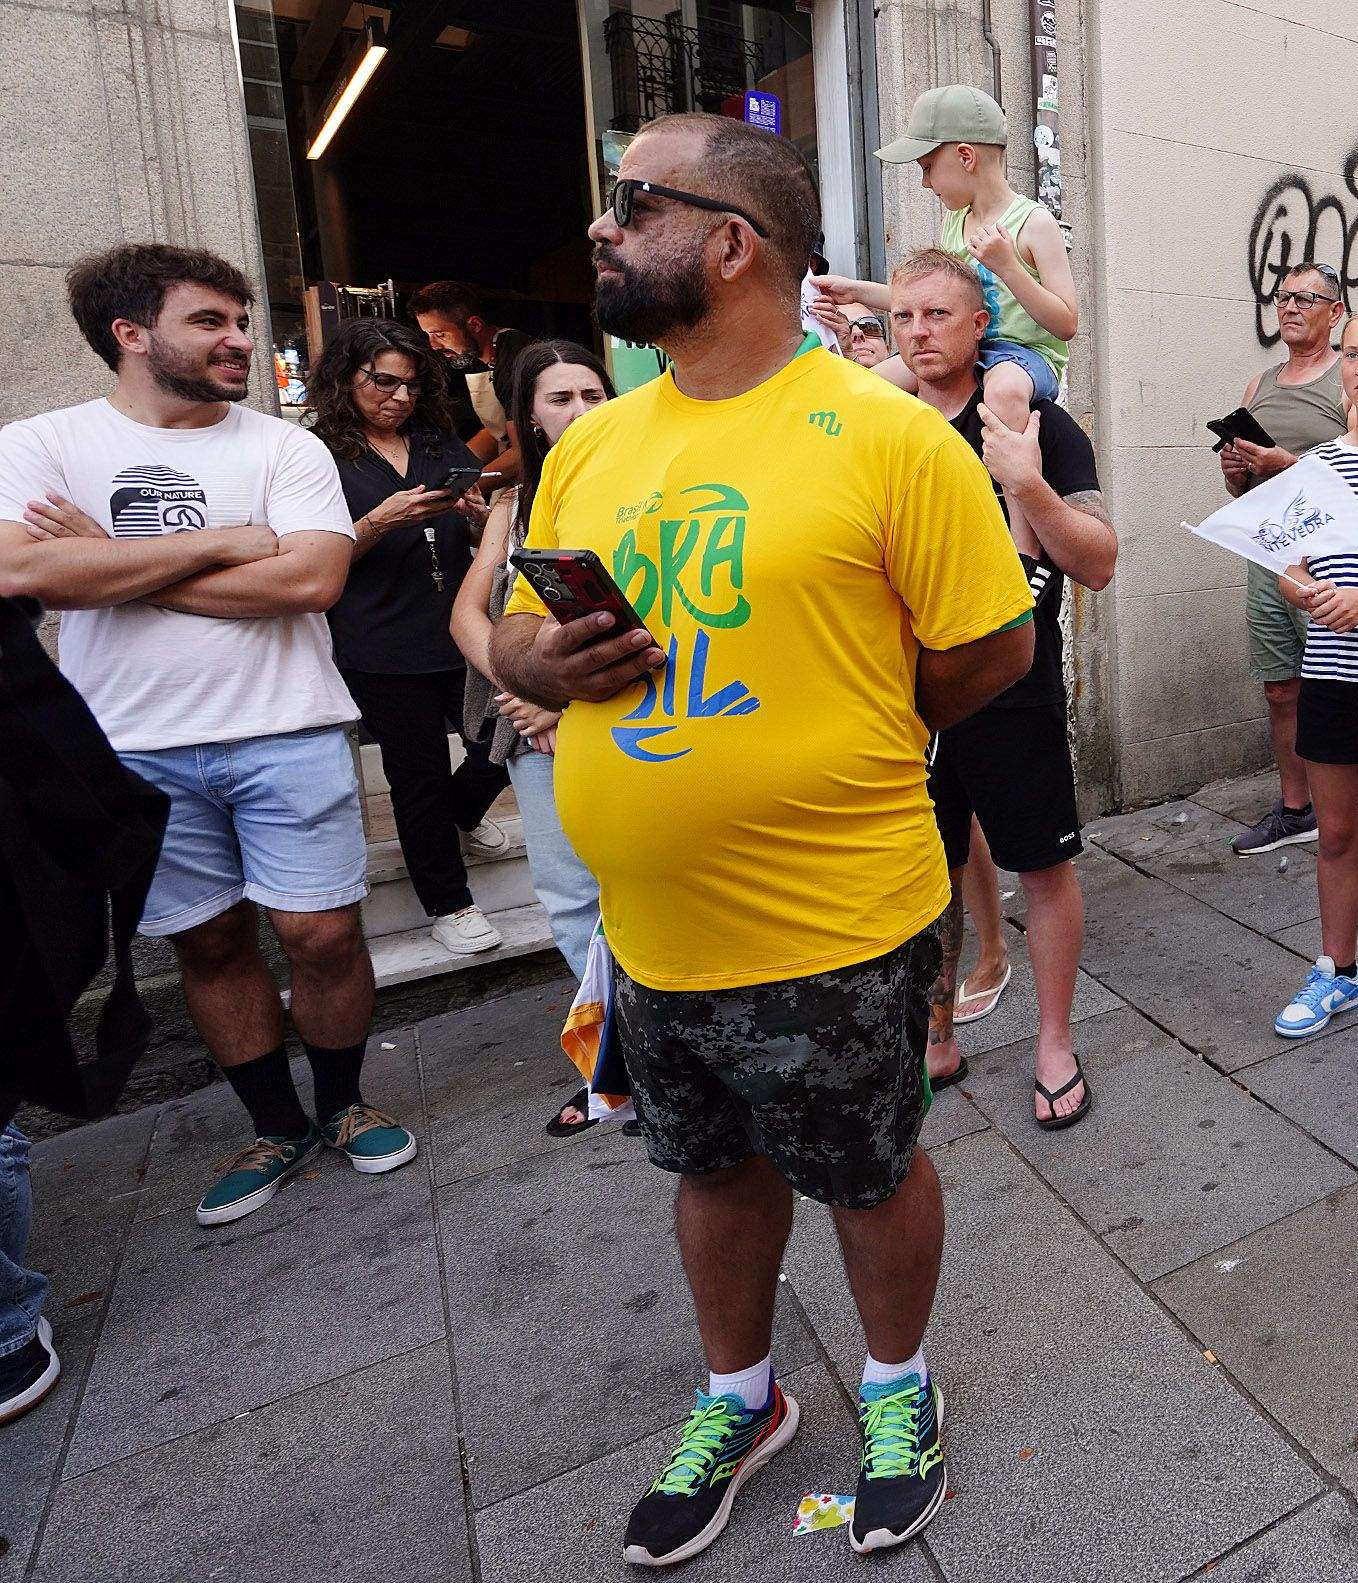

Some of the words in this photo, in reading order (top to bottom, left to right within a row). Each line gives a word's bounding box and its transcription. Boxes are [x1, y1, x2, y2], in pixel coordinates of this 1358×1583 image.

[140, 488, 163, 499] OUR
[164, 490, 203, 500] NATURE
[1059, 831, 1075, 844] BOSS
